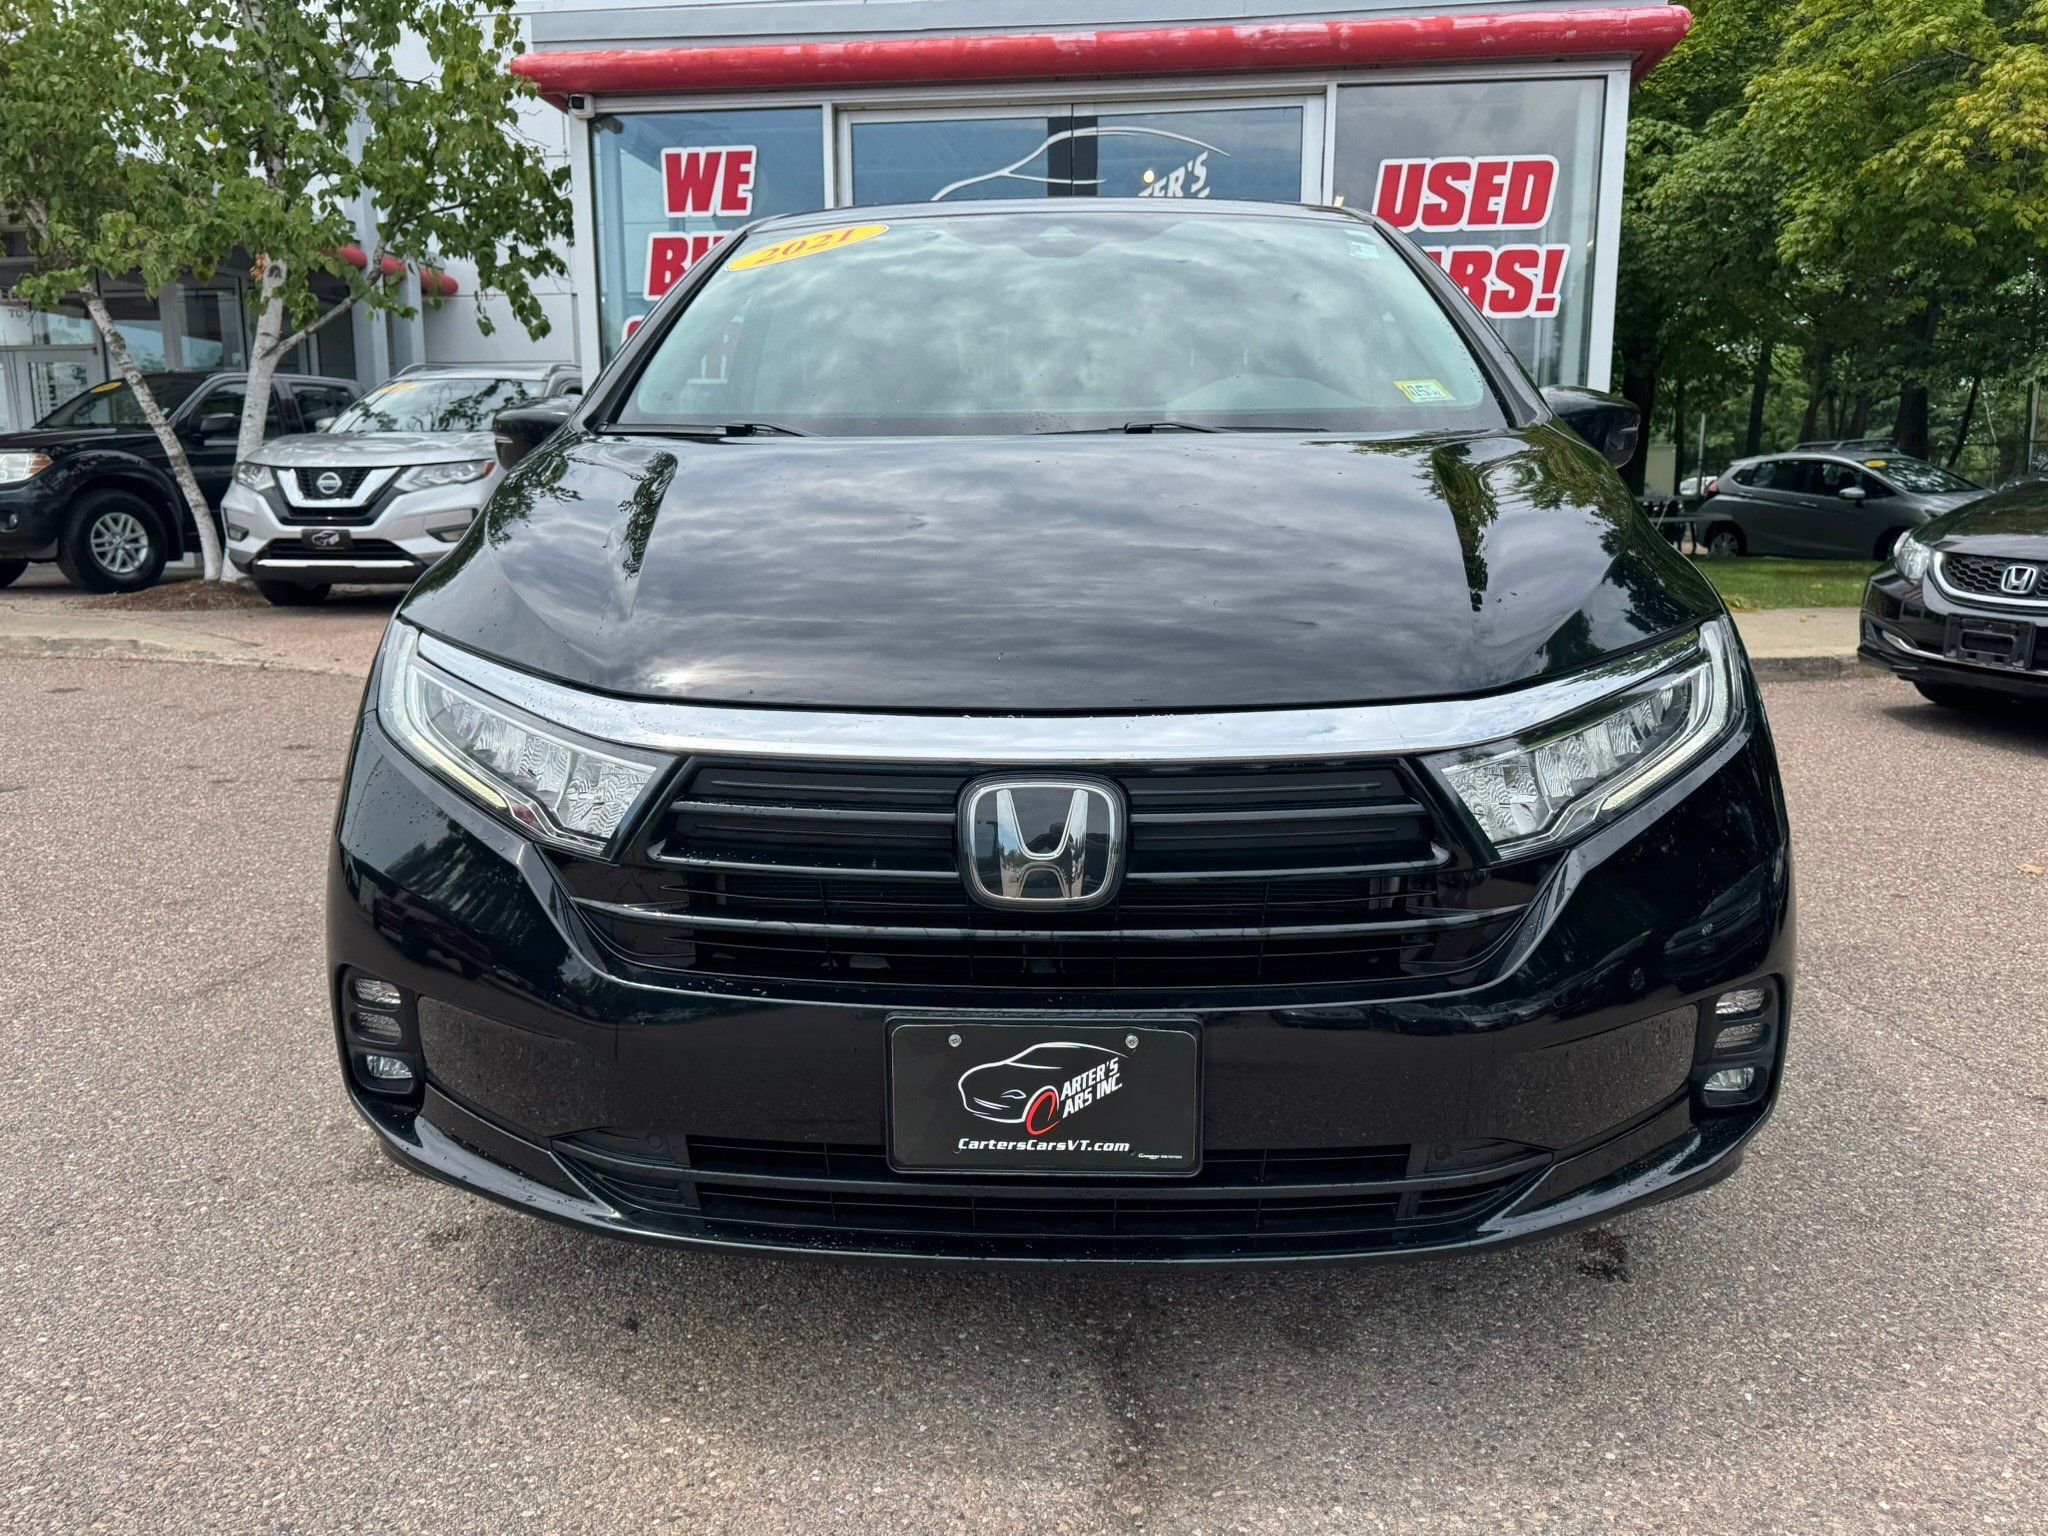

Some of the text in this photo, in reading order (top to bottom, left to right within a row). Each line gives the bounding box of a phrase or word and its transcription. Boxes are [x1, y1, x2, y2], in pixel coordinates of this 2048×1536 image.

[662, 147, 756, 215] WE
[1374, 159, 1556, 229] USED
[754, 229, 855, 265] 2021
[1428, 247, 1567, 314] RS!
[1096, 1072, 1123, 1100] INC.
[957, 1137, 1130, 1152] CartersCarsVT.com
